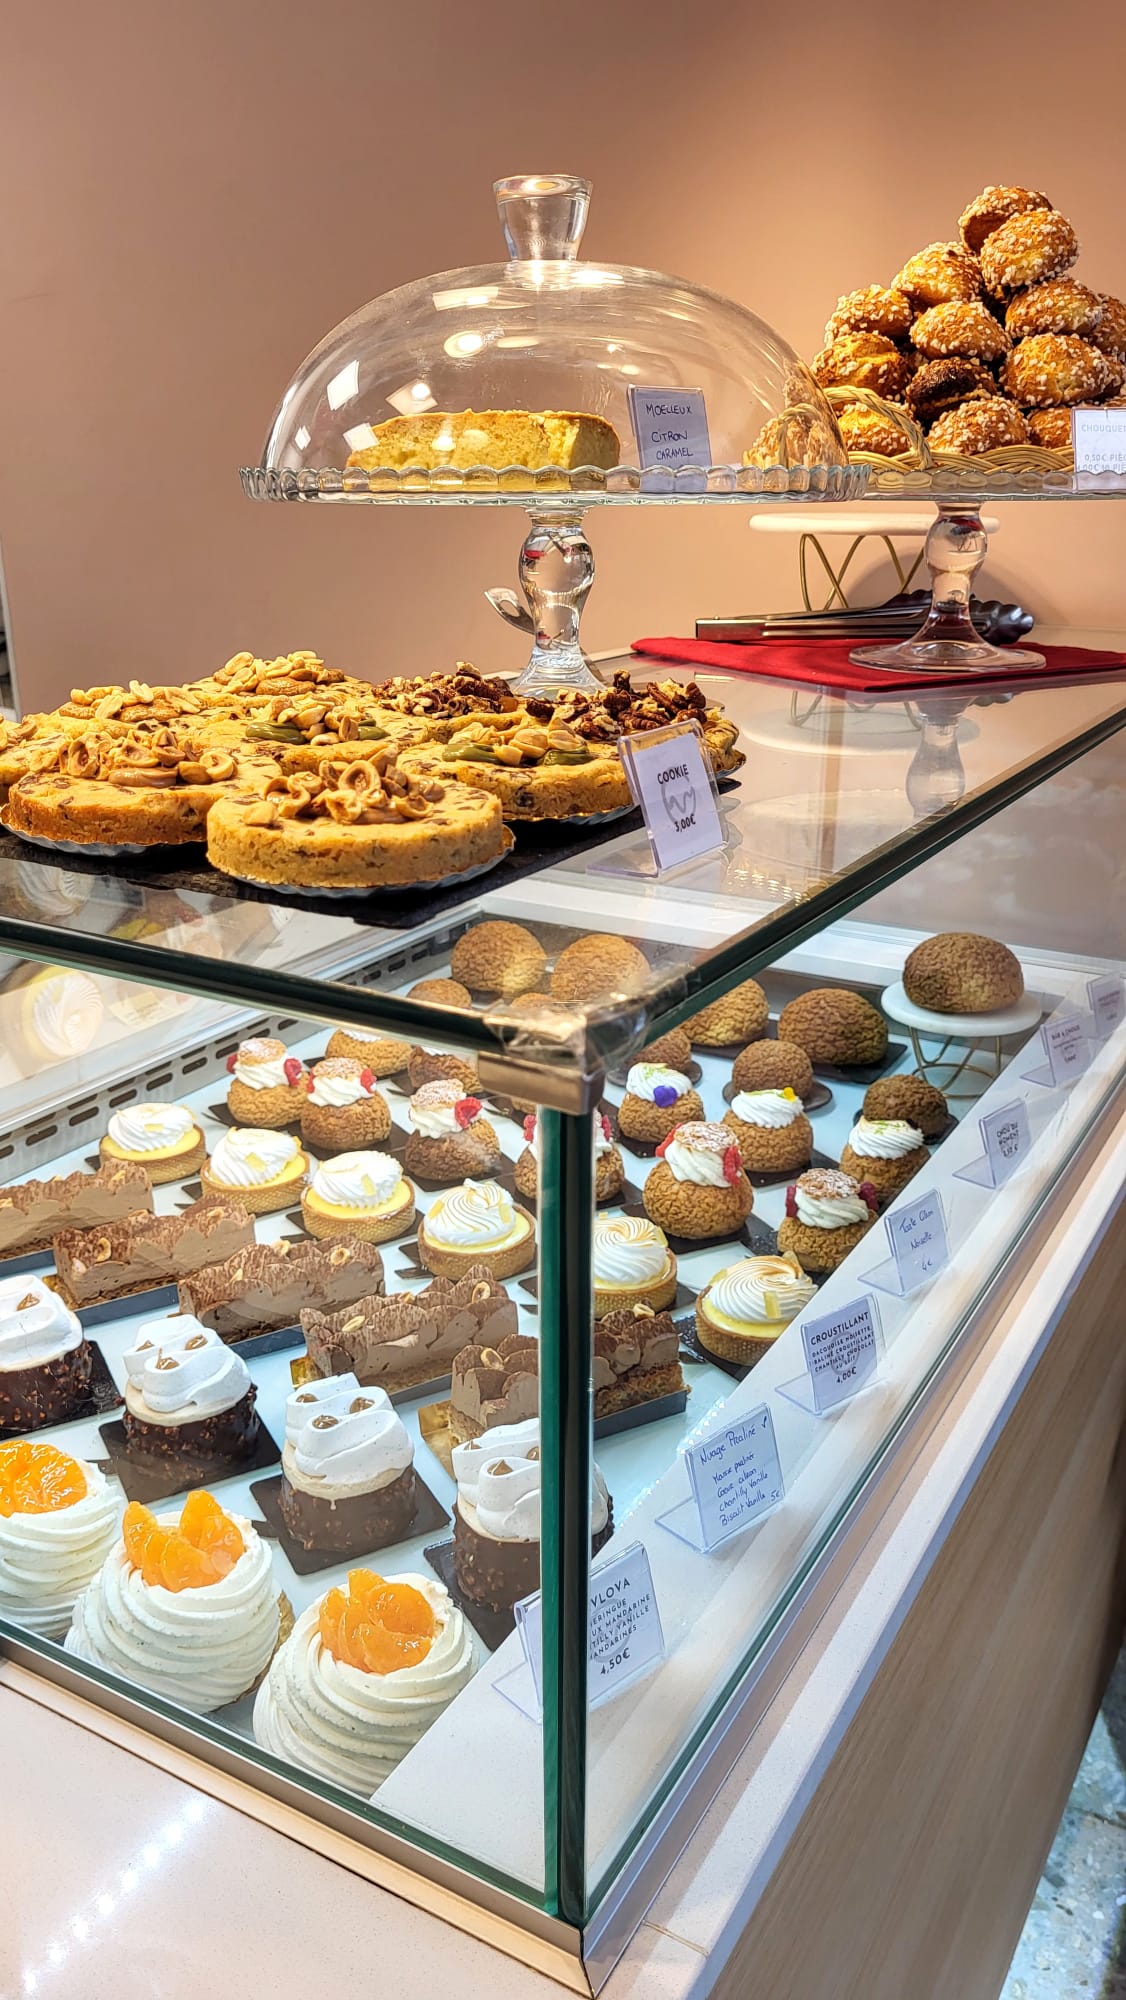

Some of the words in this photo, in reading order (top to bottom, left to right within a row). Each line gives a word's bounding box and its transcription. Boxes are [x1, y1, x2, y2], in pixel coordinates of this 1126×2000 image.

[646, 404, 693, 418] MOELLEUX
[656, 447, 693, 460] CARAMEL
[657, 764, 689, 784] COOKIE
[674, 813, 696, 832] 3,00€
[811, 1311, 869, 1345] CROUSTILLANT
[836, 1366, 857, 1384] 4,00€
[591, 1577, 631, 1608] VLOVA
[600, 1647, 631, 1676] 4,50€
